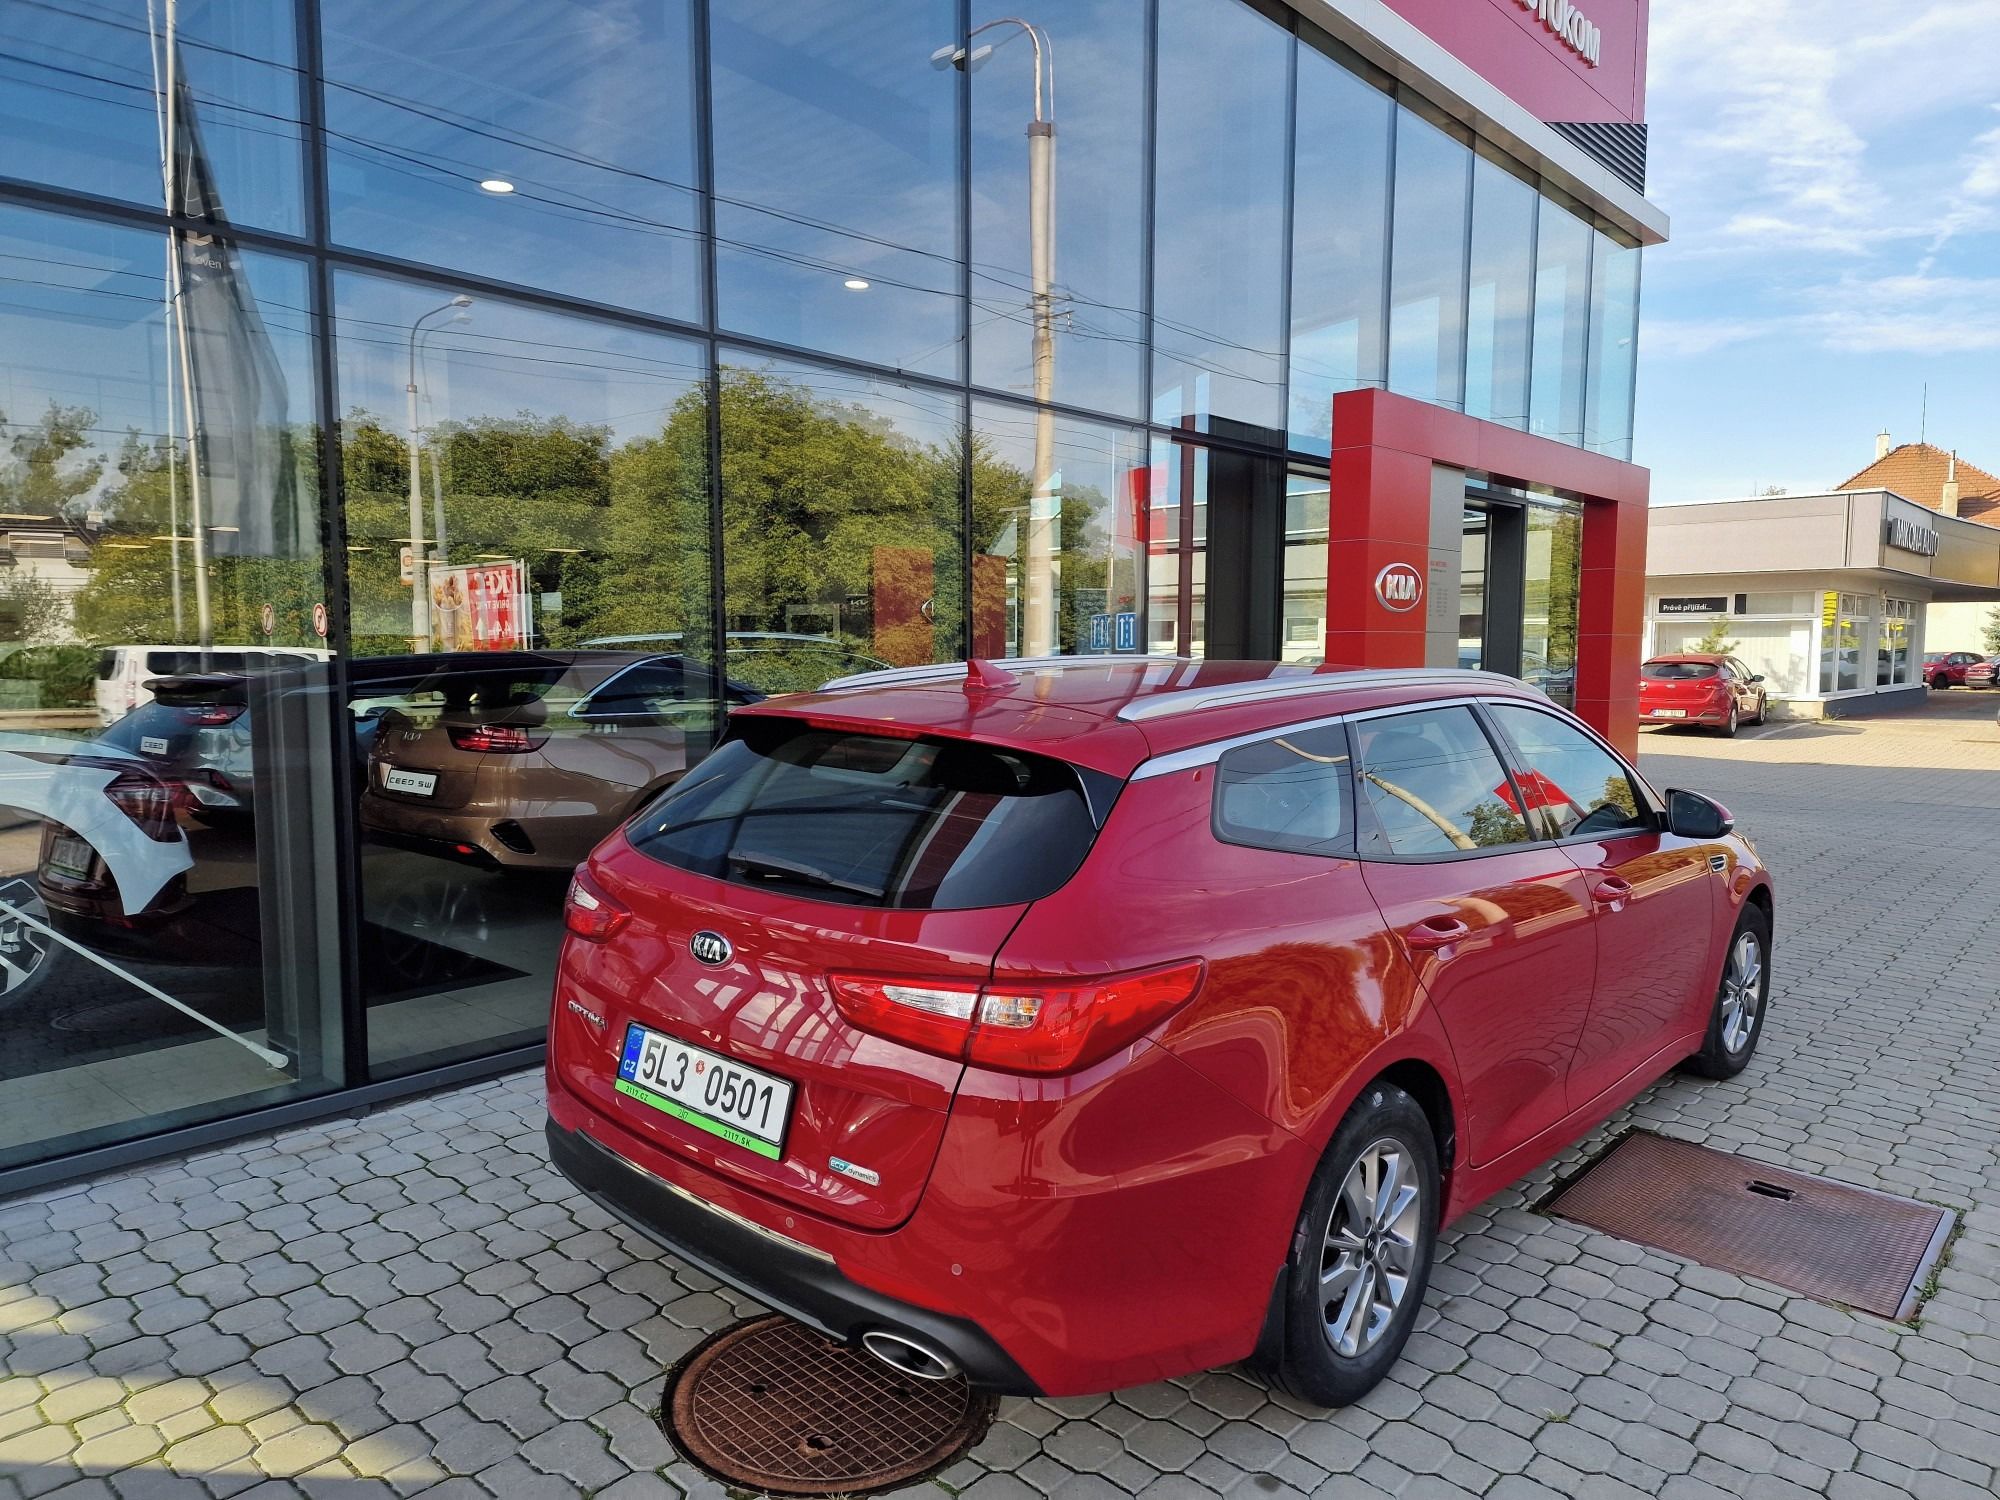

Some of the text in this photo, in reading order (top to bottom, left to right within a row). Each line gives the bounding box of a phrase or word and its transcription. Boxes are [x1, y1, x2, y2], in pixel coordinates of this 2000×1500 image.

[1922, 528, 1940, 557] AUTO
[1386, 574, 1416, 601] KIA
[1663, 603, 1682, 612] Právě
[389, 776, 433, 789] CEED SW
[693, 934, 721, 961] KIA
[568, 1000, 609, 1031] OPTIMA
[623, 1059, 637, 1074] CZ
[625, 1085, 649, 1102] 2117.CZ
[642, 1039, 774, 1130] 5L3 0501
[723, 1129, 751, 1147] 2117.SK
[847, 1168, 877, 1183] dynamics
